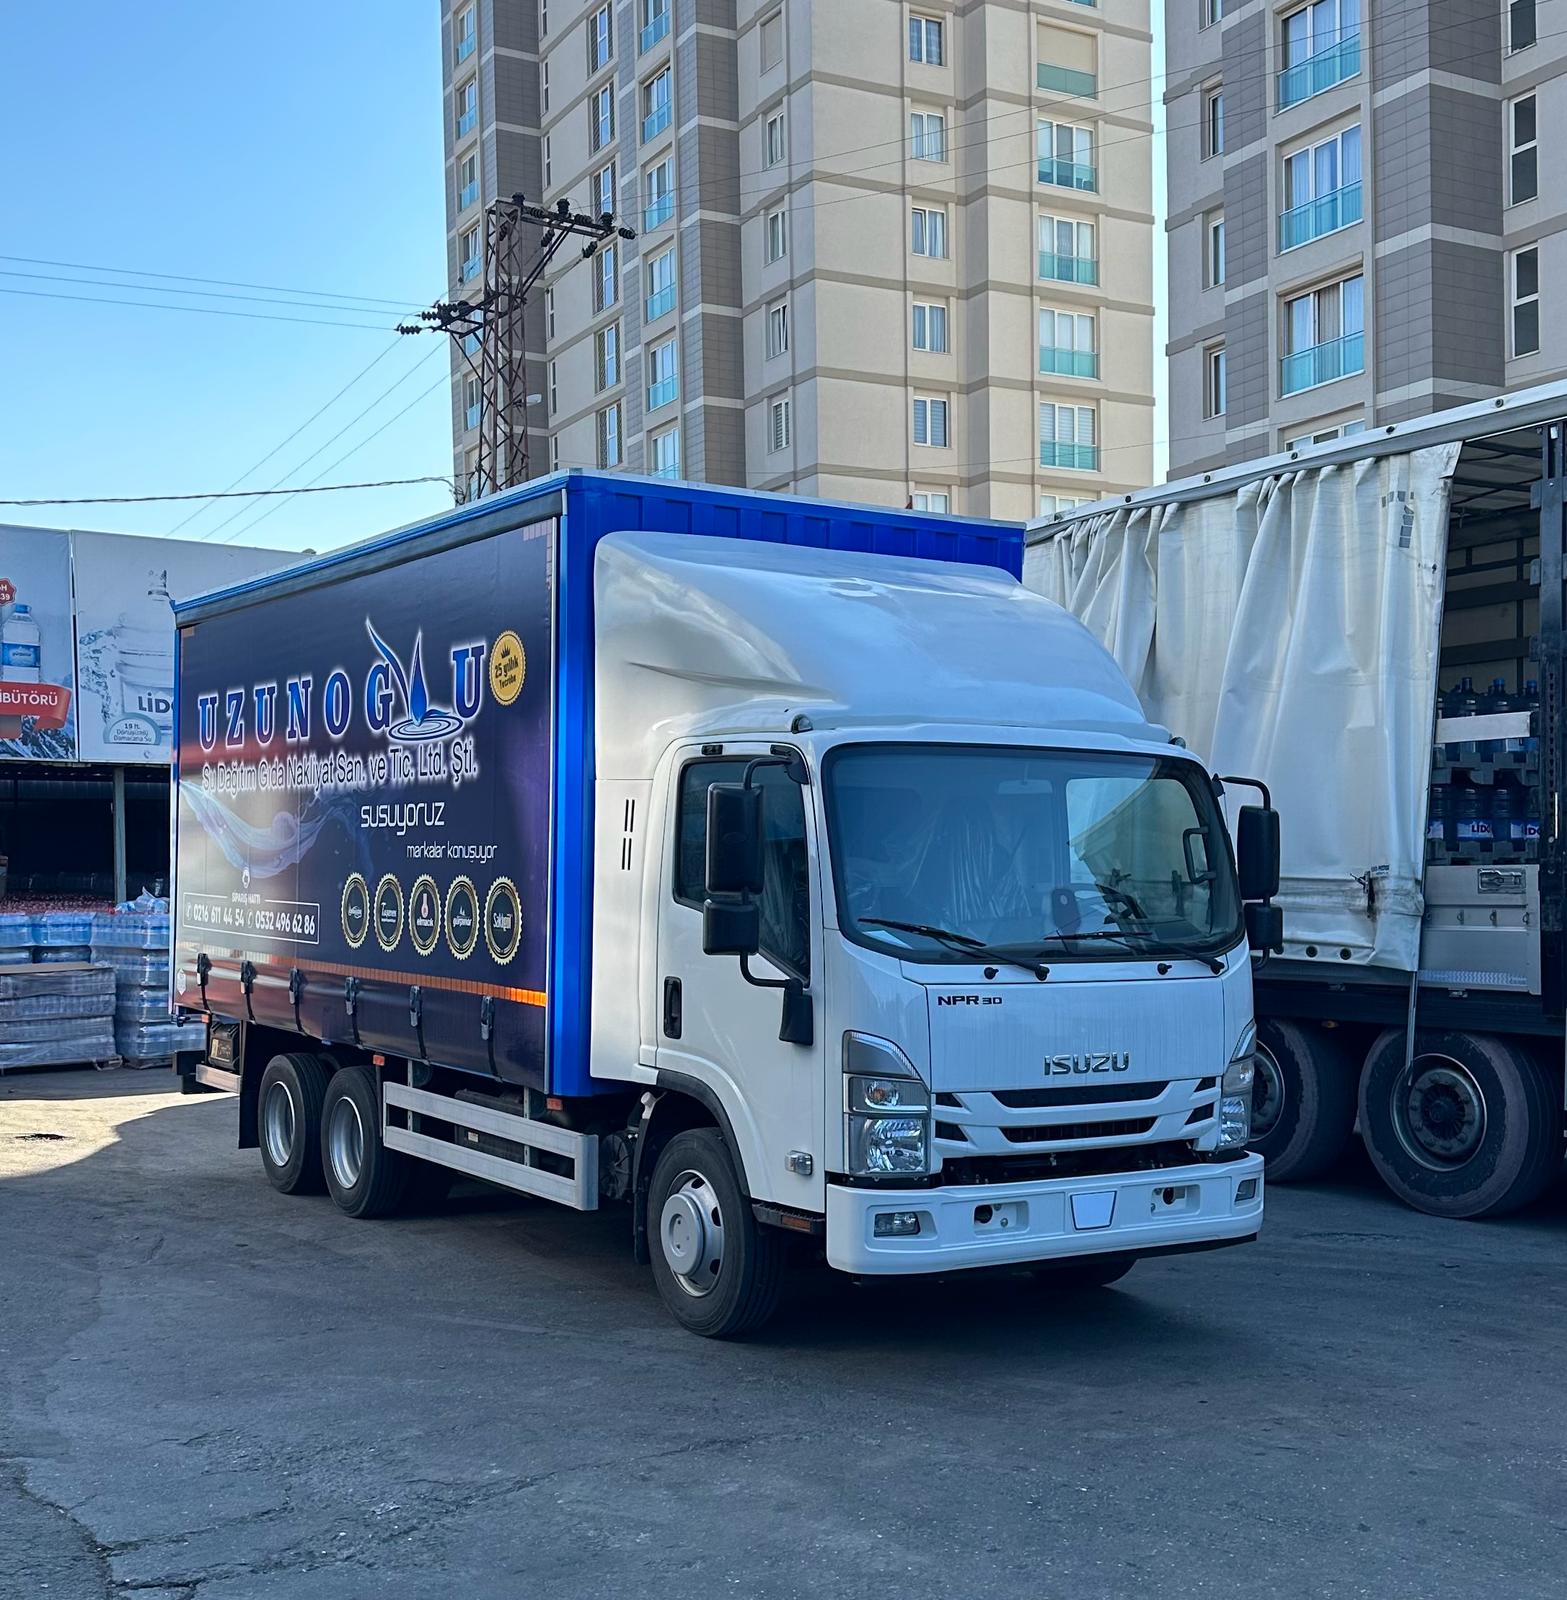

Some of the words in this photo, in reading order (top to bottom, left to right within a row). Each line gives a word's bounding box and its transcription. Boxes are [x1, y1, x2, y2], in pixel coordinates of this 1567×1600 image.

[202, 763, 217, 791] Su
[217, 761, 256, 798] Dağıtım
[259, 756, 285, 789] Gıda
[287, 752, 334, 792] Nakliyat
[336, 752, 367, 784] San.
[369, 754, 386, 781] ve
[418, 742, 447, 777] Ltd.
[452, 738, 478, 783] Şti.
[360, 801, 445, 836] susuyoruz
[406, 840, 446, 859] markalar
[447, 840, 498, 864] konuşuyor
[193, 903, 209, 923] 0216
[210, 905, 221, 924] 611
[223, 907, 233, 926] 44
[235, 908, 245, 928] 54
[255, 910, 275, 931] 0532
[275, 912, 291, 933] 496
[292, 913, 303, 934] 62
[303, 914, 315, 936] 86
[937, 995, 980, 1006] NPR
[982, 996, 1003, 1005] 30
[1043, 1051, 1130, 1076] ISUZU
